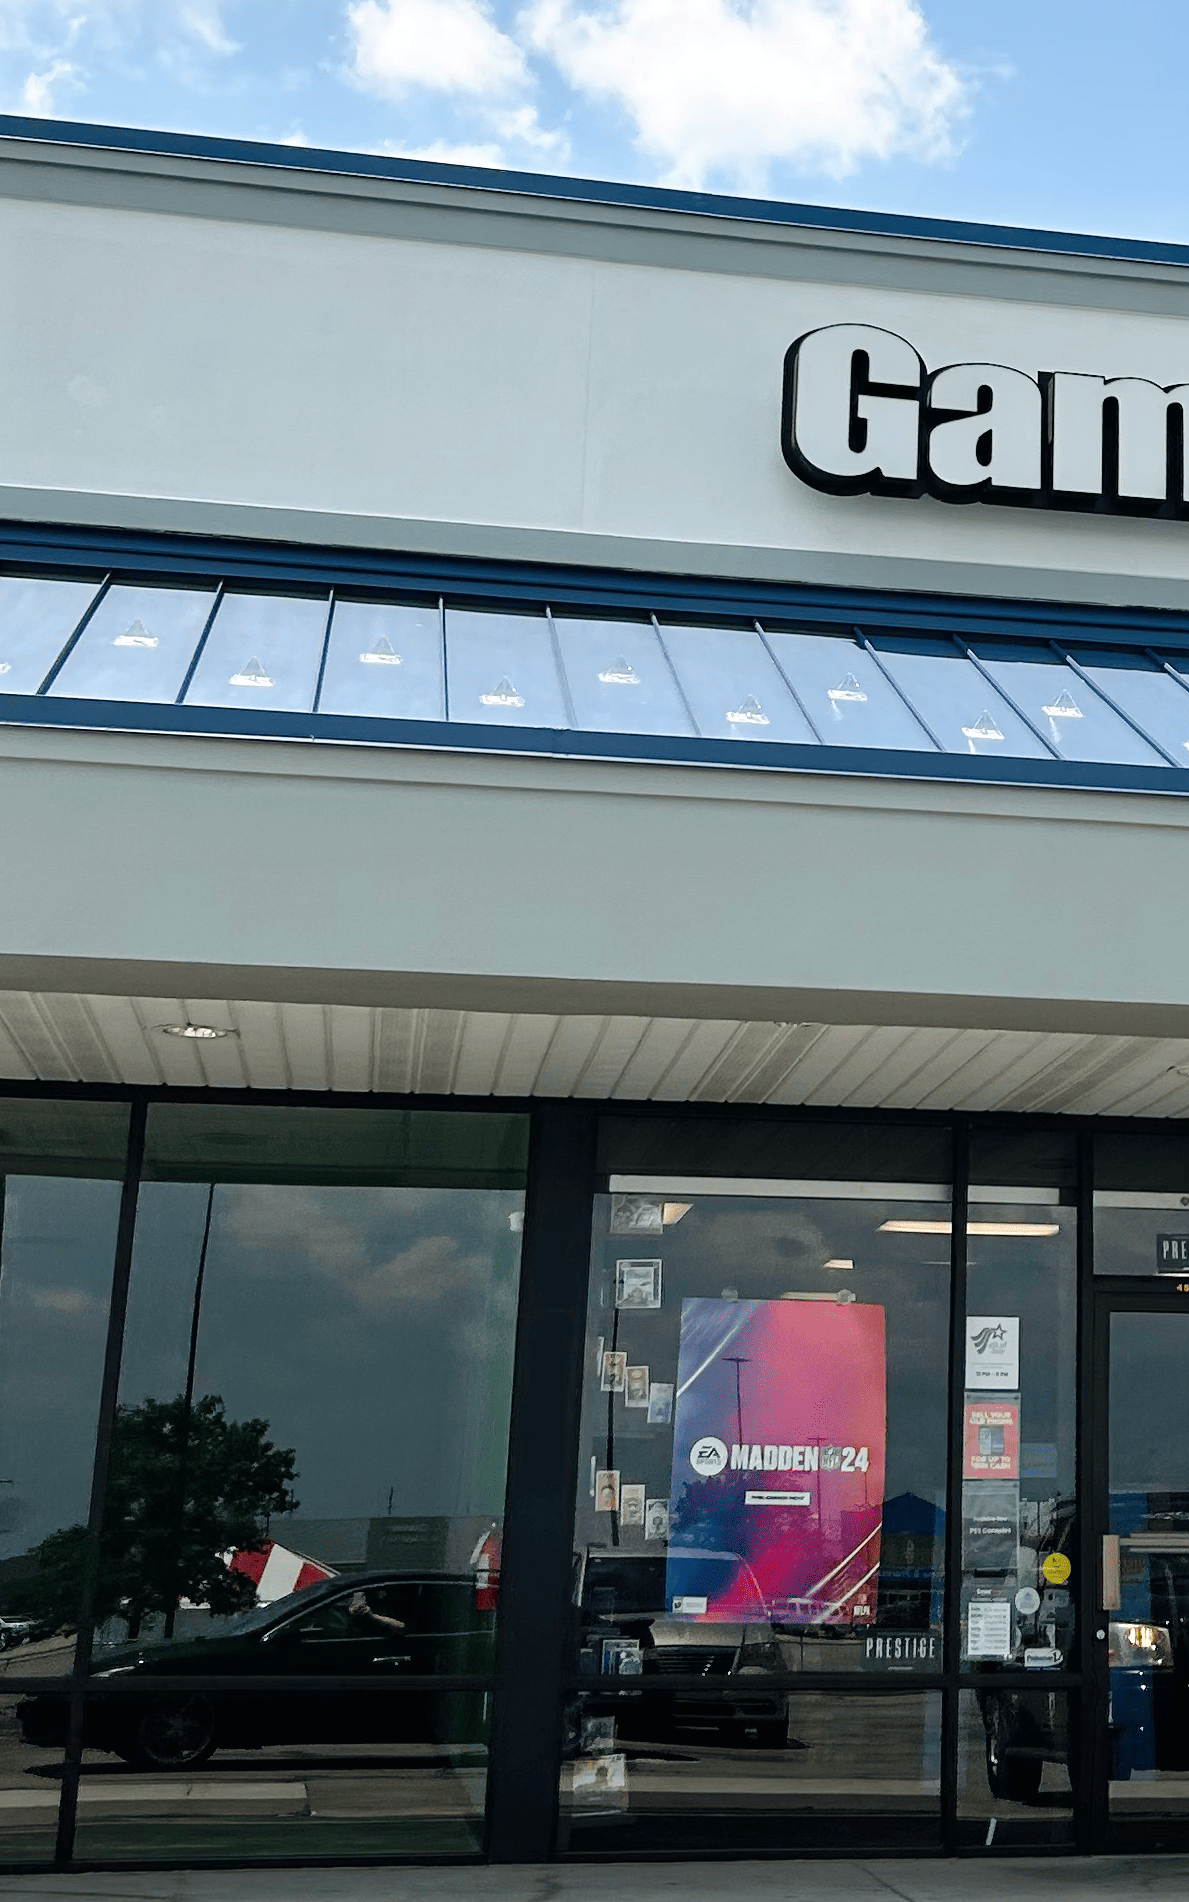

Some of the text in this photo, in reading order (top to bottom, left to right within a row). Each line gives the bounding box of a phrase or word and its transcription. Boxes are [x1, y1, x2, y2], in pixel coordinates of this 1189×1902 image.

[730, 1444, 819, 1471] MADDEN
[841, 1447, 869, 1473] 24
[866, 1637, 935, 1659] PRESTIGE
